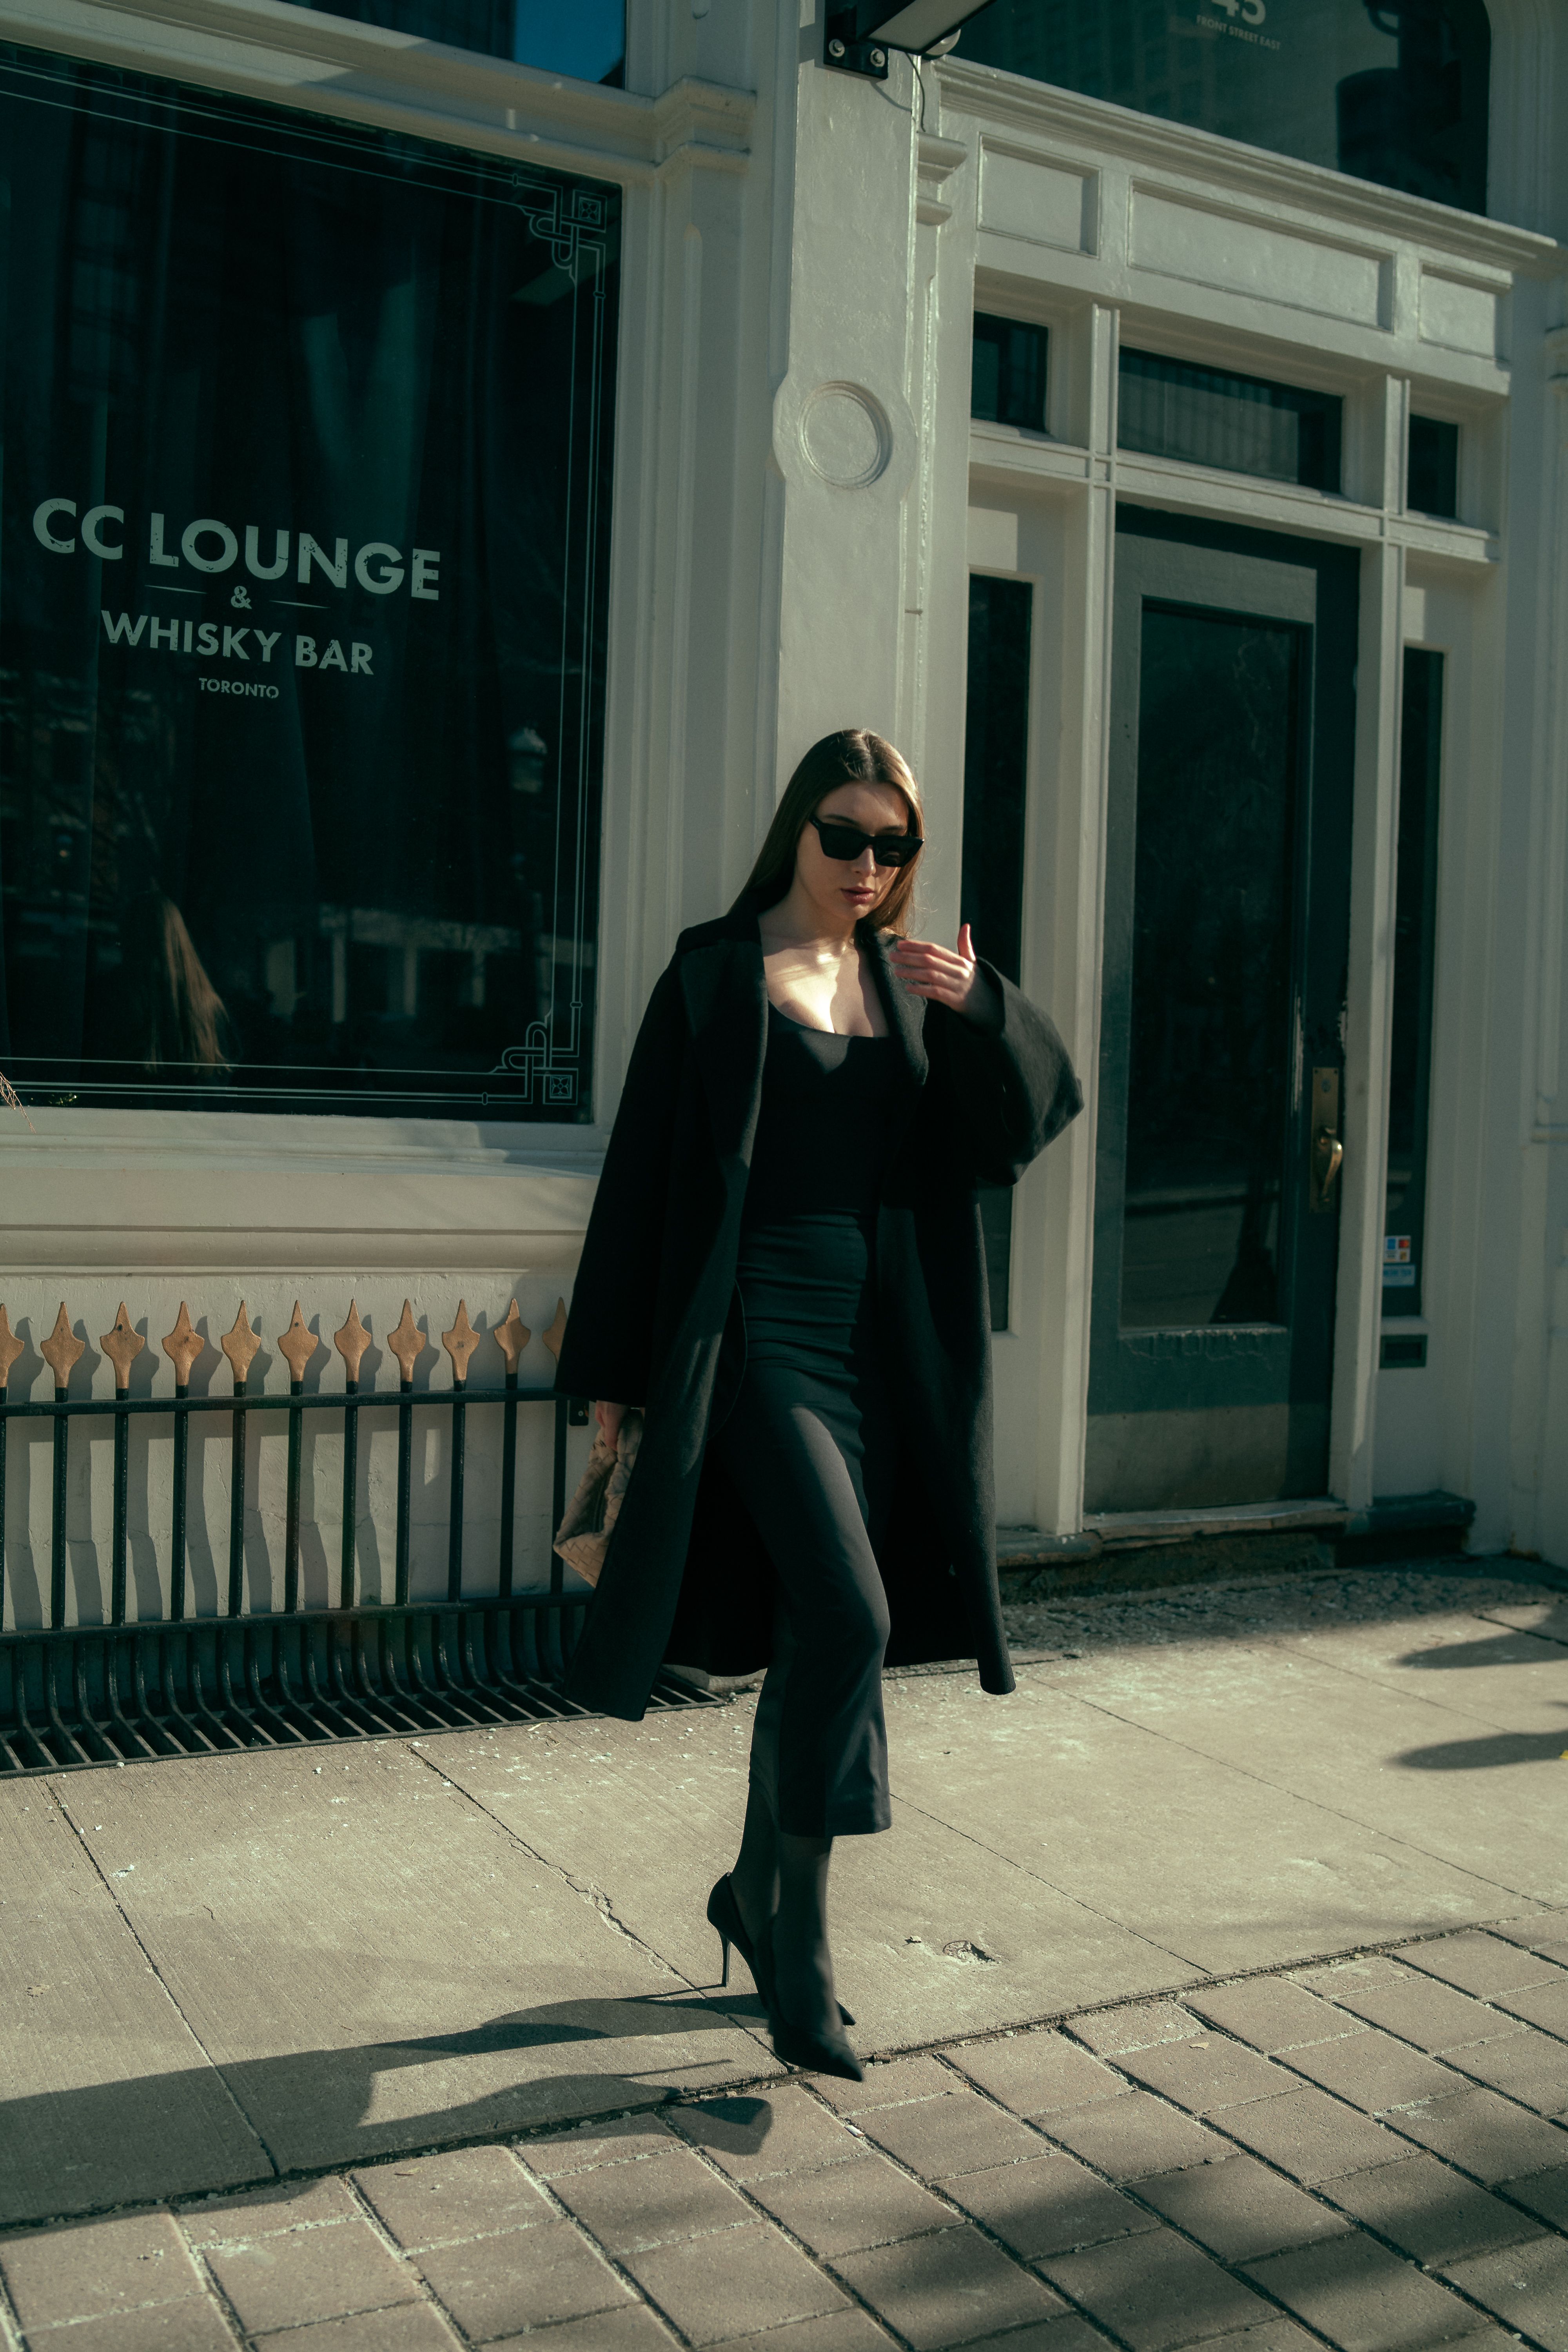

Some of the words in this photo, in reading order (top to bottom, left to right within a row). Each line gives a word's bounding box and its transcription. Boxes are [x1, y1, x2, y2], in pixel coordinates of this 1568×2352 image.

[1196, 15, 1227, 33] FRONT
[1229, 26, 1258, 44] STREET
[1259, 36, 1281, 50] EAST
[33, 499, 124, 560] CC
[150, 513, 440, 600] LOUNGE
[230, 586, 252, 609] &
[101, 610, 282, 662] WHISKY
[296, 635, 374, 675] BAR
[199, 678, 279, 699] TORONTO
